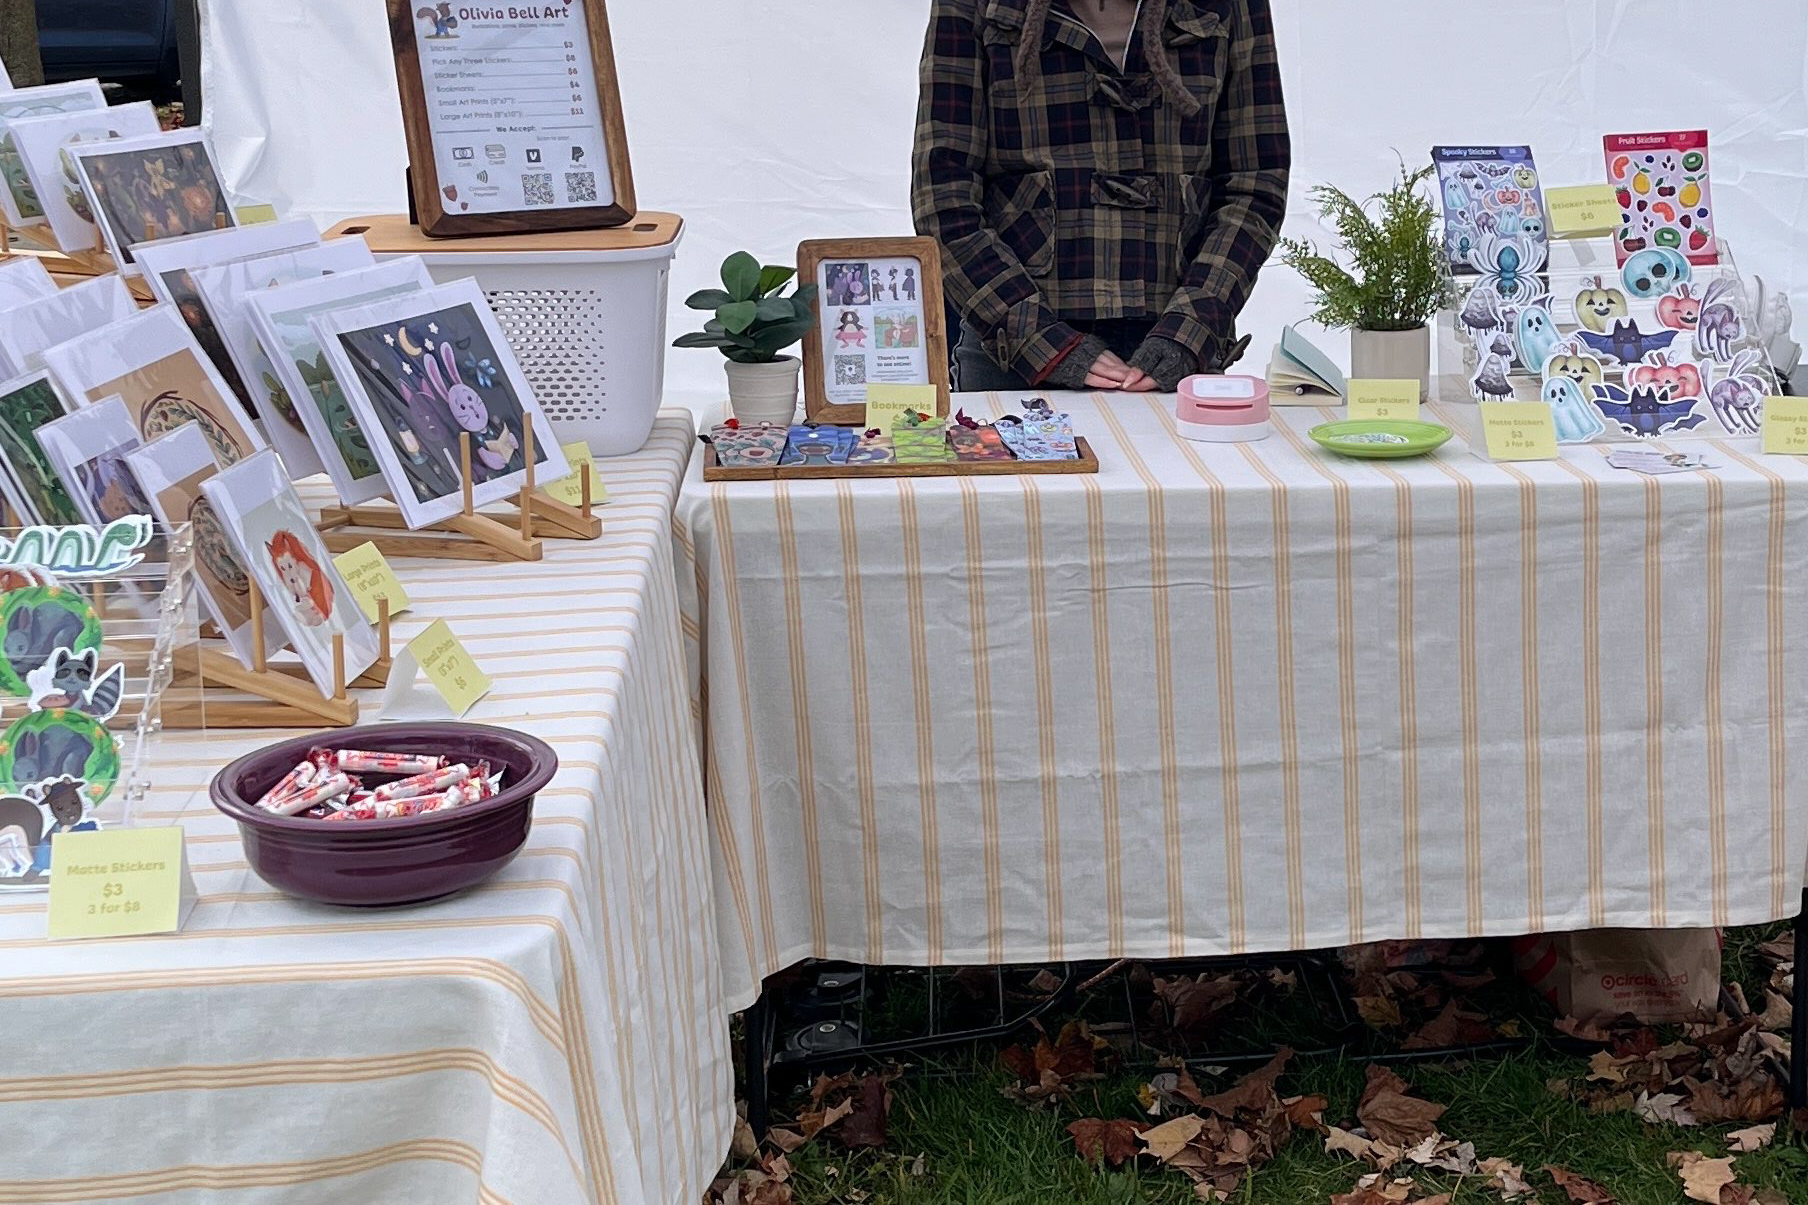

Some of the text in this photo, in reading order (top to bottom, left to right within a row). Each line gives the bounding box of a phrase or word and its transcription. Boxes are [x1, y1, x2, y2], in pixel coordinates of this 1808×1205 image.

[459, 5, 569, 21] Olivia Bell Art
[569, 80, 580, 89] $4
[462, 112, 473, 120] Art
[1618, 137, 1636, 145] Fruit
[1636, 136, 1666, 144] Stickers
[1441, 148, 1468, 157] Spooky
[1551, 200, 1584, 210] Sticker
[871, 400, 932, 411] Bookmarks
[1357, 396, 1410, 405] Clear Stickers
[1376, 407, 1389, 417] $3
[1488, 418, 1545, 427] Matte Stickers
[1770, 414, 1798, 424] Glossy
[1511, 430, 1523, 440] $3
[1794, 426, 1807, 436] $3
[1512, 440, 1523, 448] for
[1785, 437, 1806, 445] 3 for
[343, 559, 382, 582] Large Prints
[422, 638, 456, 668] Small Prints
[67, 861, 166, 876] Matte Stickers
[103, 882, 123, 898] $3
[88, 900, 141, 915] 3 for $8
[1615, 973, 1658, 988] circle
